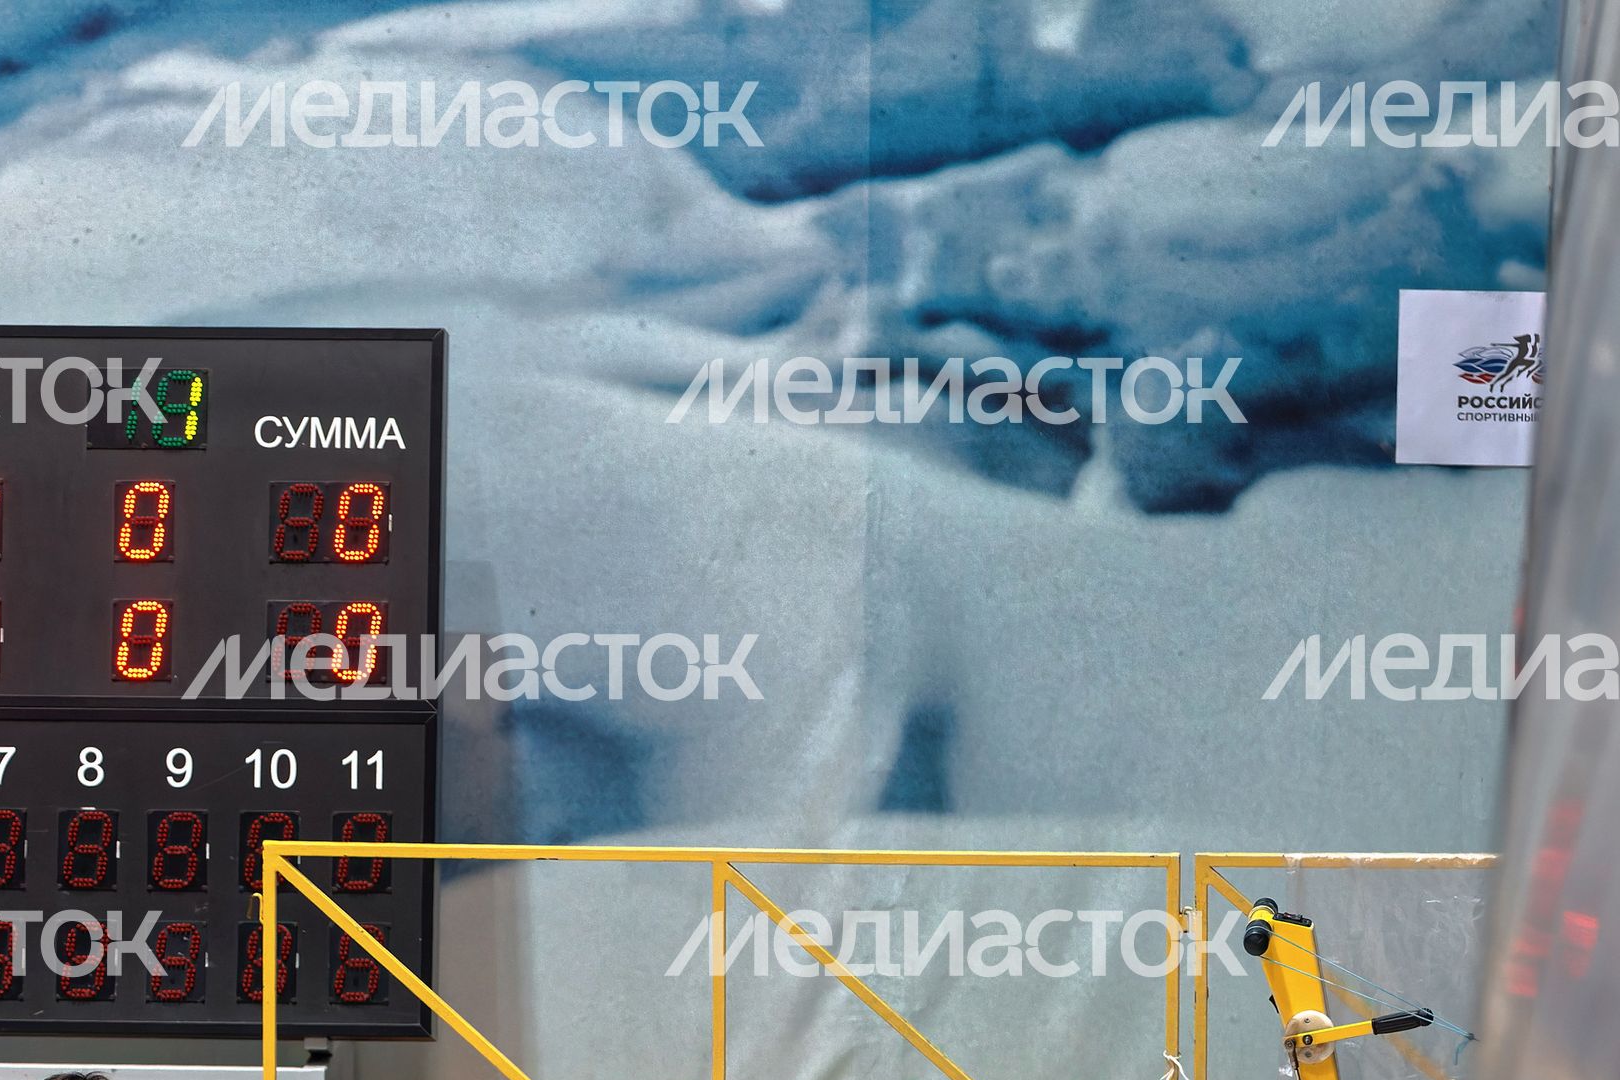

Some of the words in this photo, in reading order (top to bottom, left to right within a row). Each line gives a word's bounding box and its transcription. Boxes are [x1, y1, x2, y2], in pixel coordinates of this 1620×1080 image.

[254, 415, 406, 450] СУММА
[1457, 411, 1540, 423] СПОРТИВНЫ
[77, 747, 105, 787] 8
[165, 747, 193, 788] 9
[245, 749, 298, 790] 10
[341, 750, 384, 790] 11
